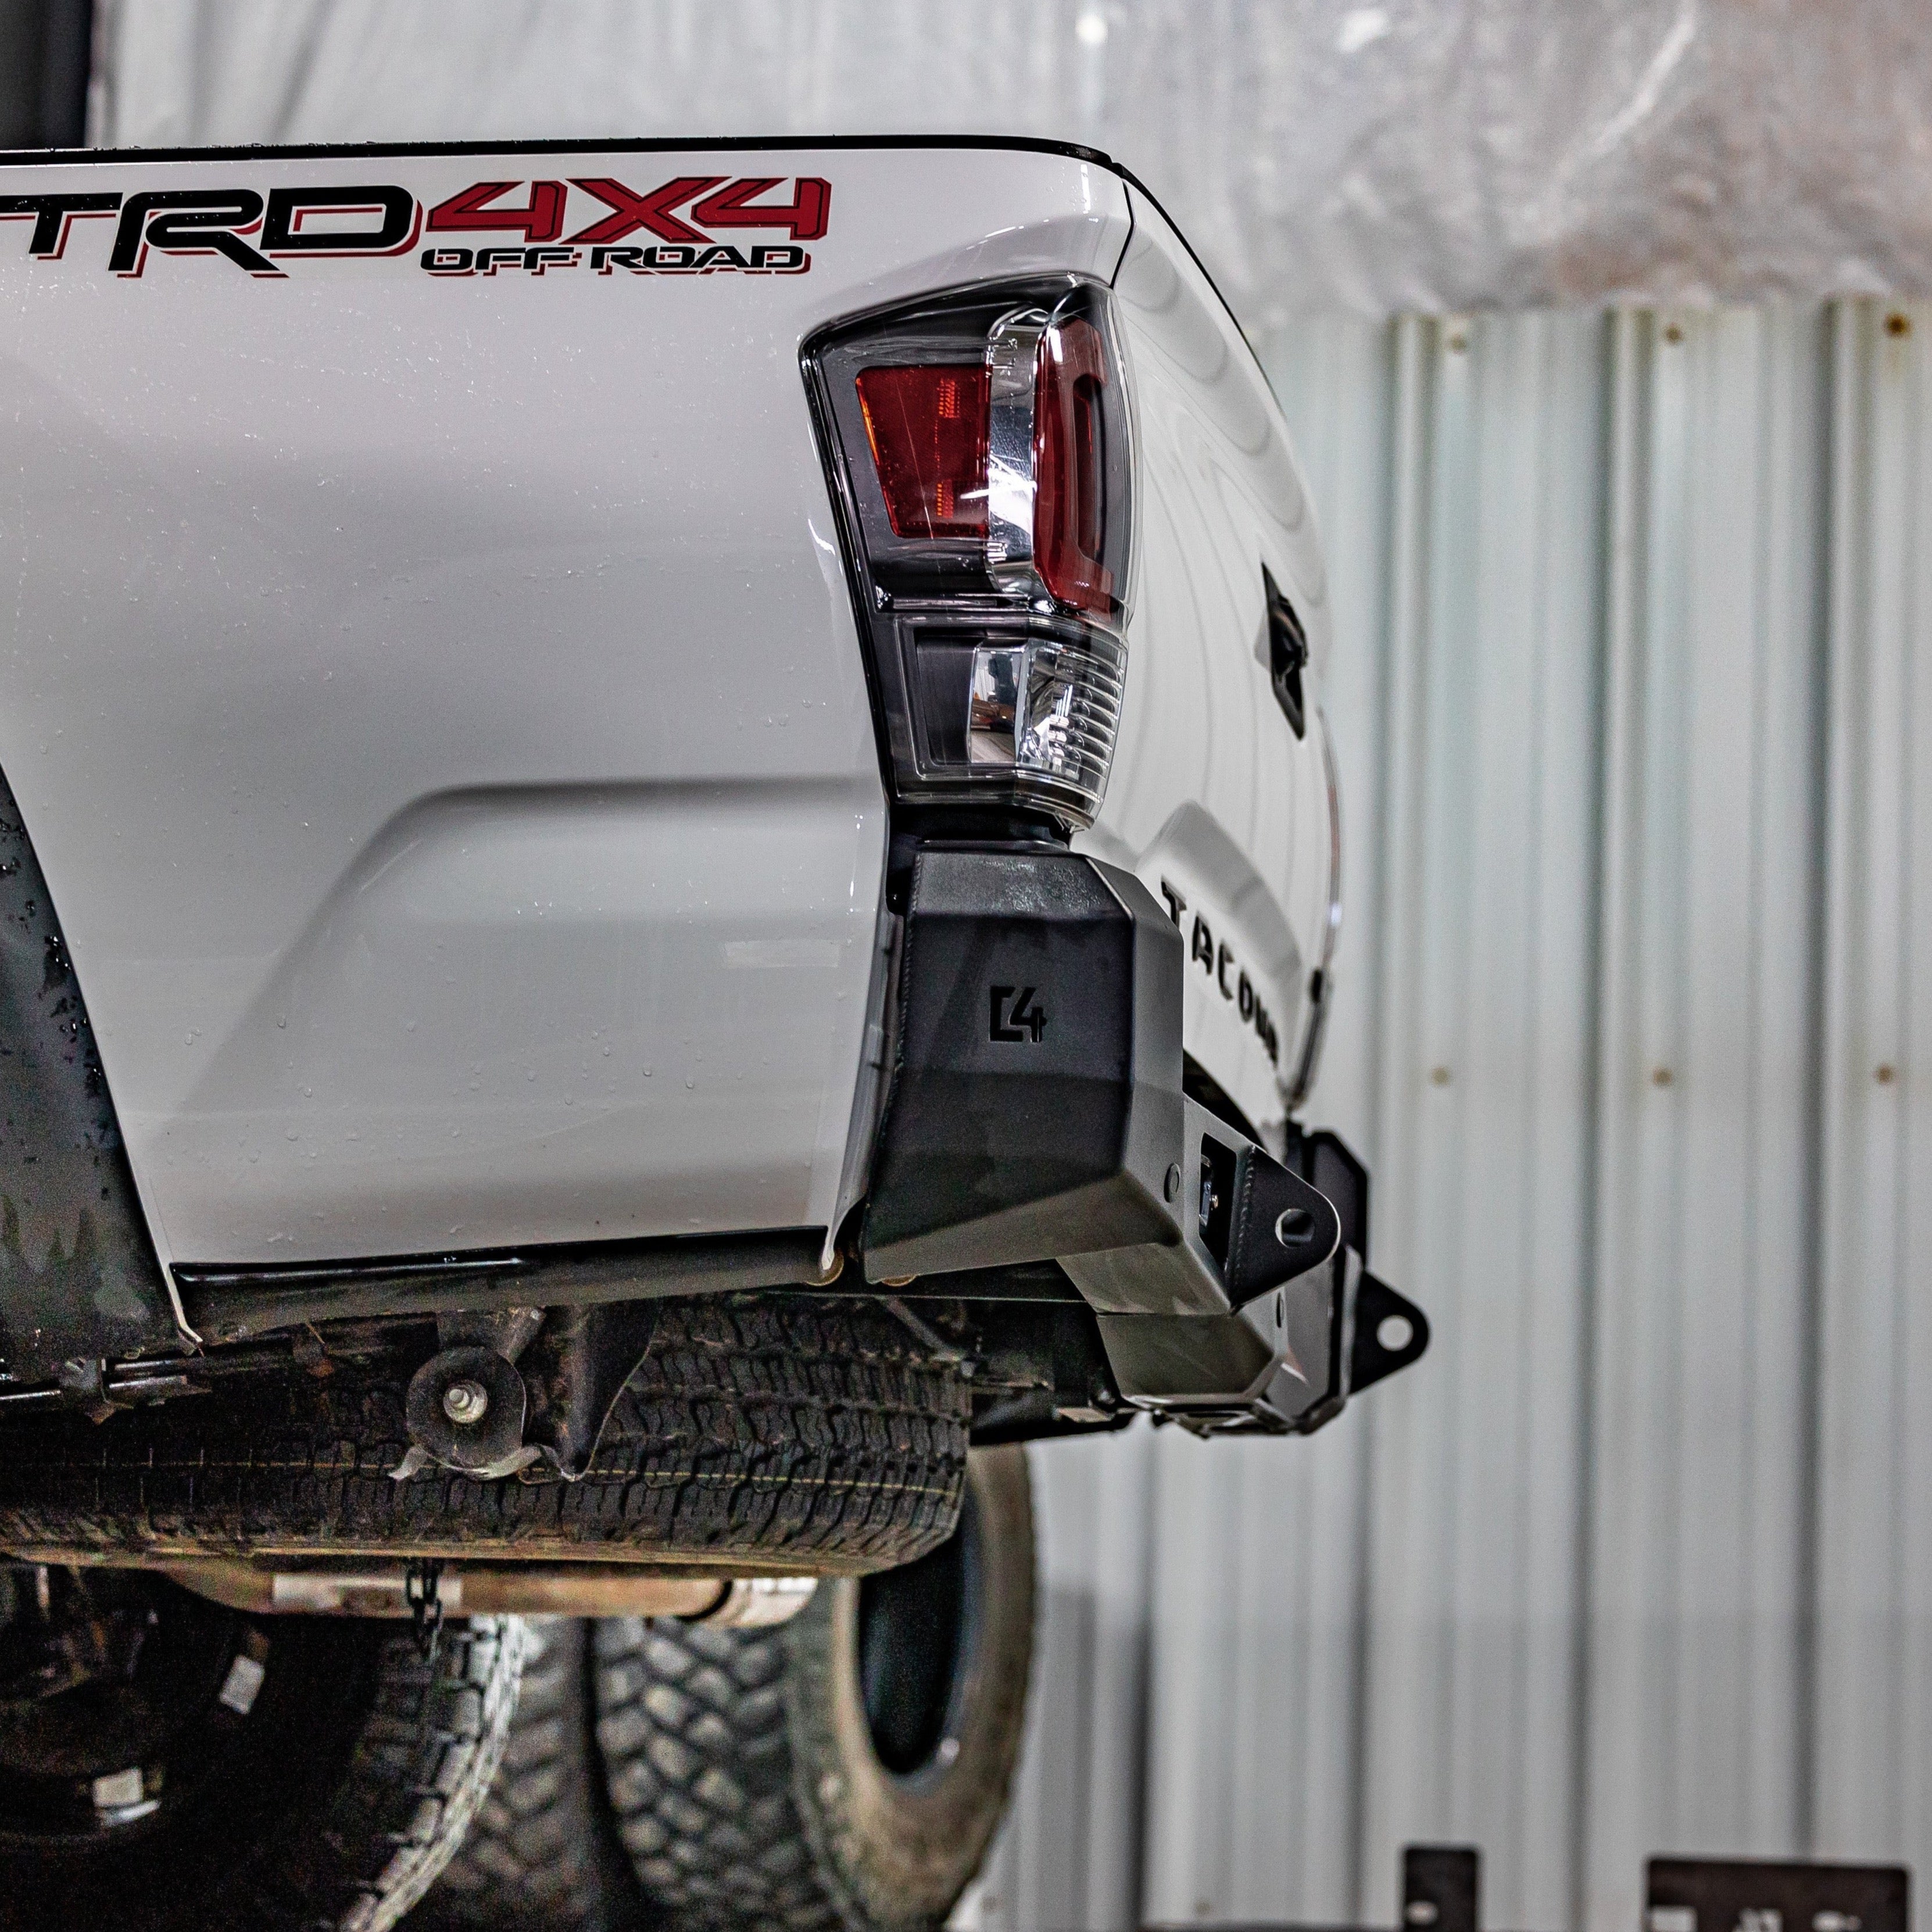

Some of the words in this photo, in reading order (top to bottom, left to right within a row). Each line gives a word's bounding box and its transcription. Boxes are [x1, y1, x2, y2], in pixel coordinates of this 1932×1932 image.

[0, 185, 423, 277] TRD
[425, 176, 832, 245] 4X4
[420, 246, 581, 277] OFF
[590, 245, 811, 276] ROAD
[989, 986, 1047, 1043] C4
